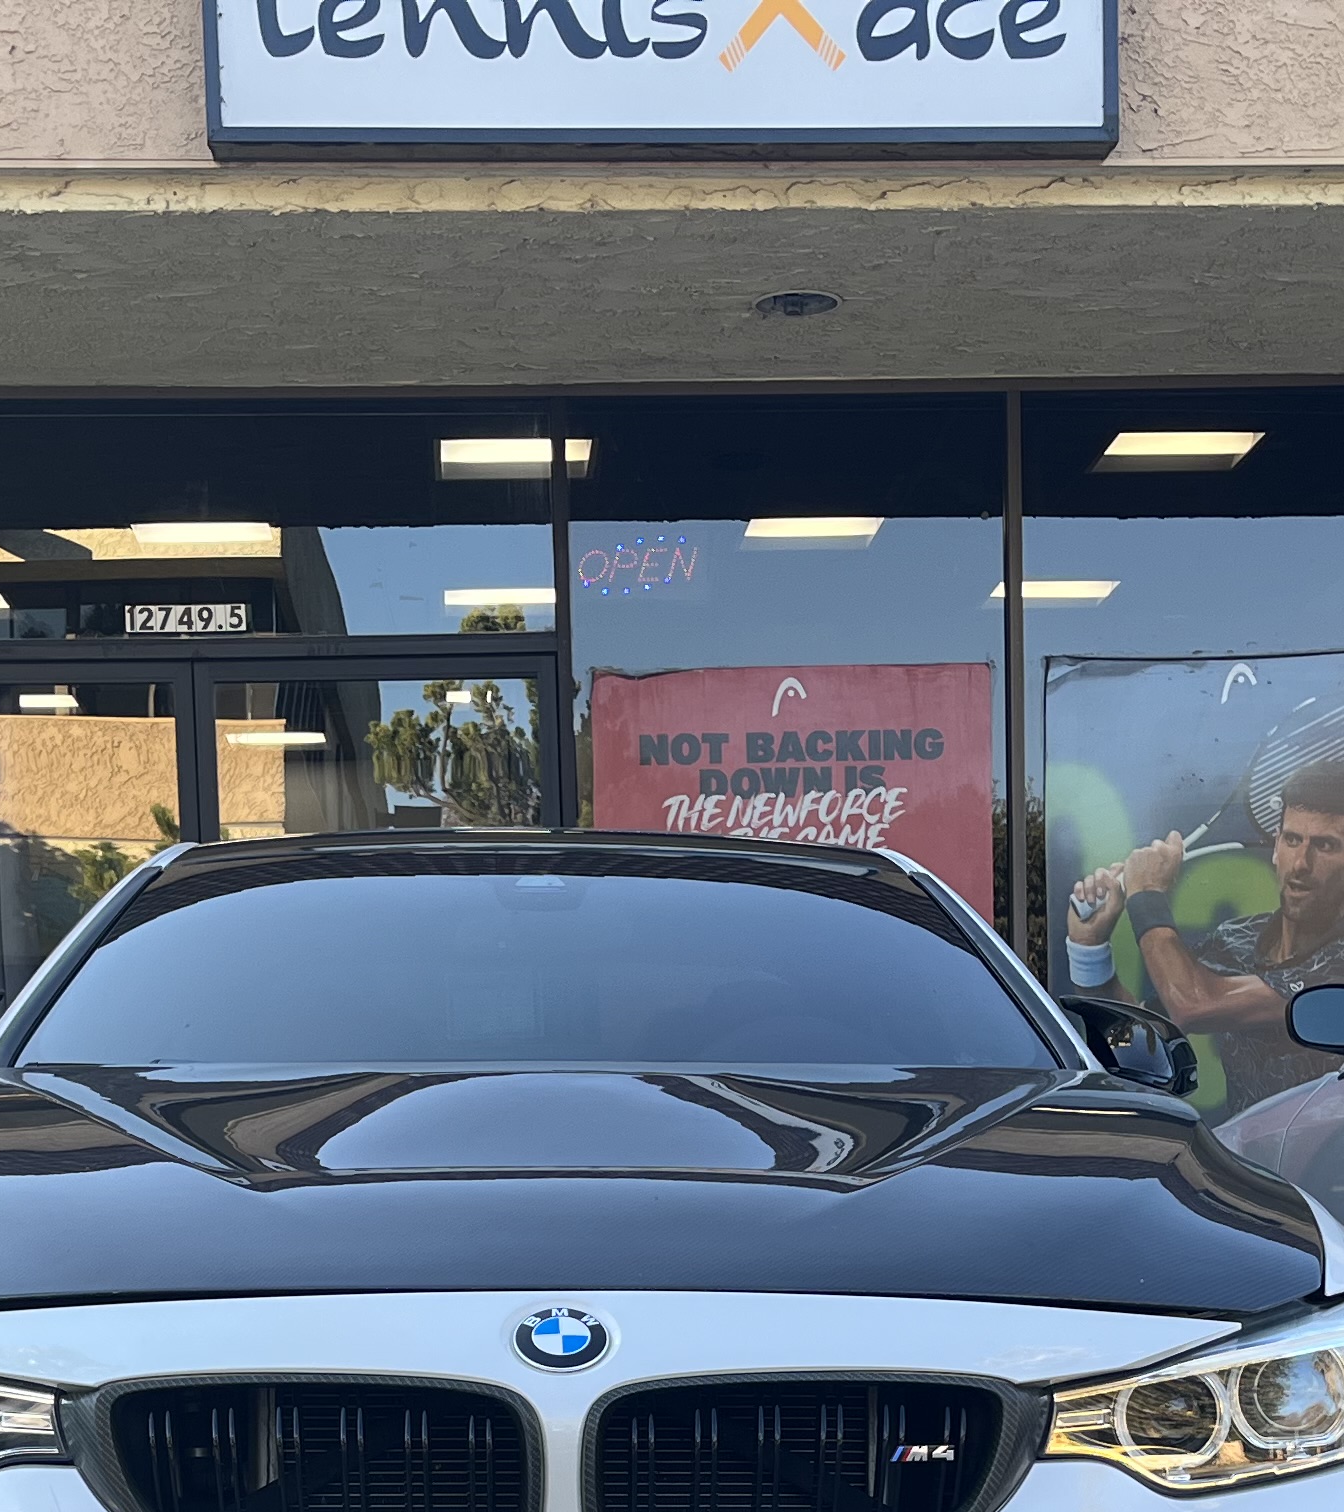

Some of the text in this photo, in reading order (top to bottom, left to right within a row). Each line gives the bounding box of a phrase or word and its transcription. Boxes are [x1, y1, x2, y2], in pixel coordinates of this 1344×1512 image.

[856, 0, 1067, 62] ace
[578, 546, 698, 583] OPEN
[127, 605, 244, 631] 12749.5
[639, 728, 945, 766] NOT BACKING
[699, 765, 887, 799] DOWN IS
[662, 793, 726, 832] THE
[523, 1308, 599, 1327] BMW
[902, 1445, 954, 1461] M4
